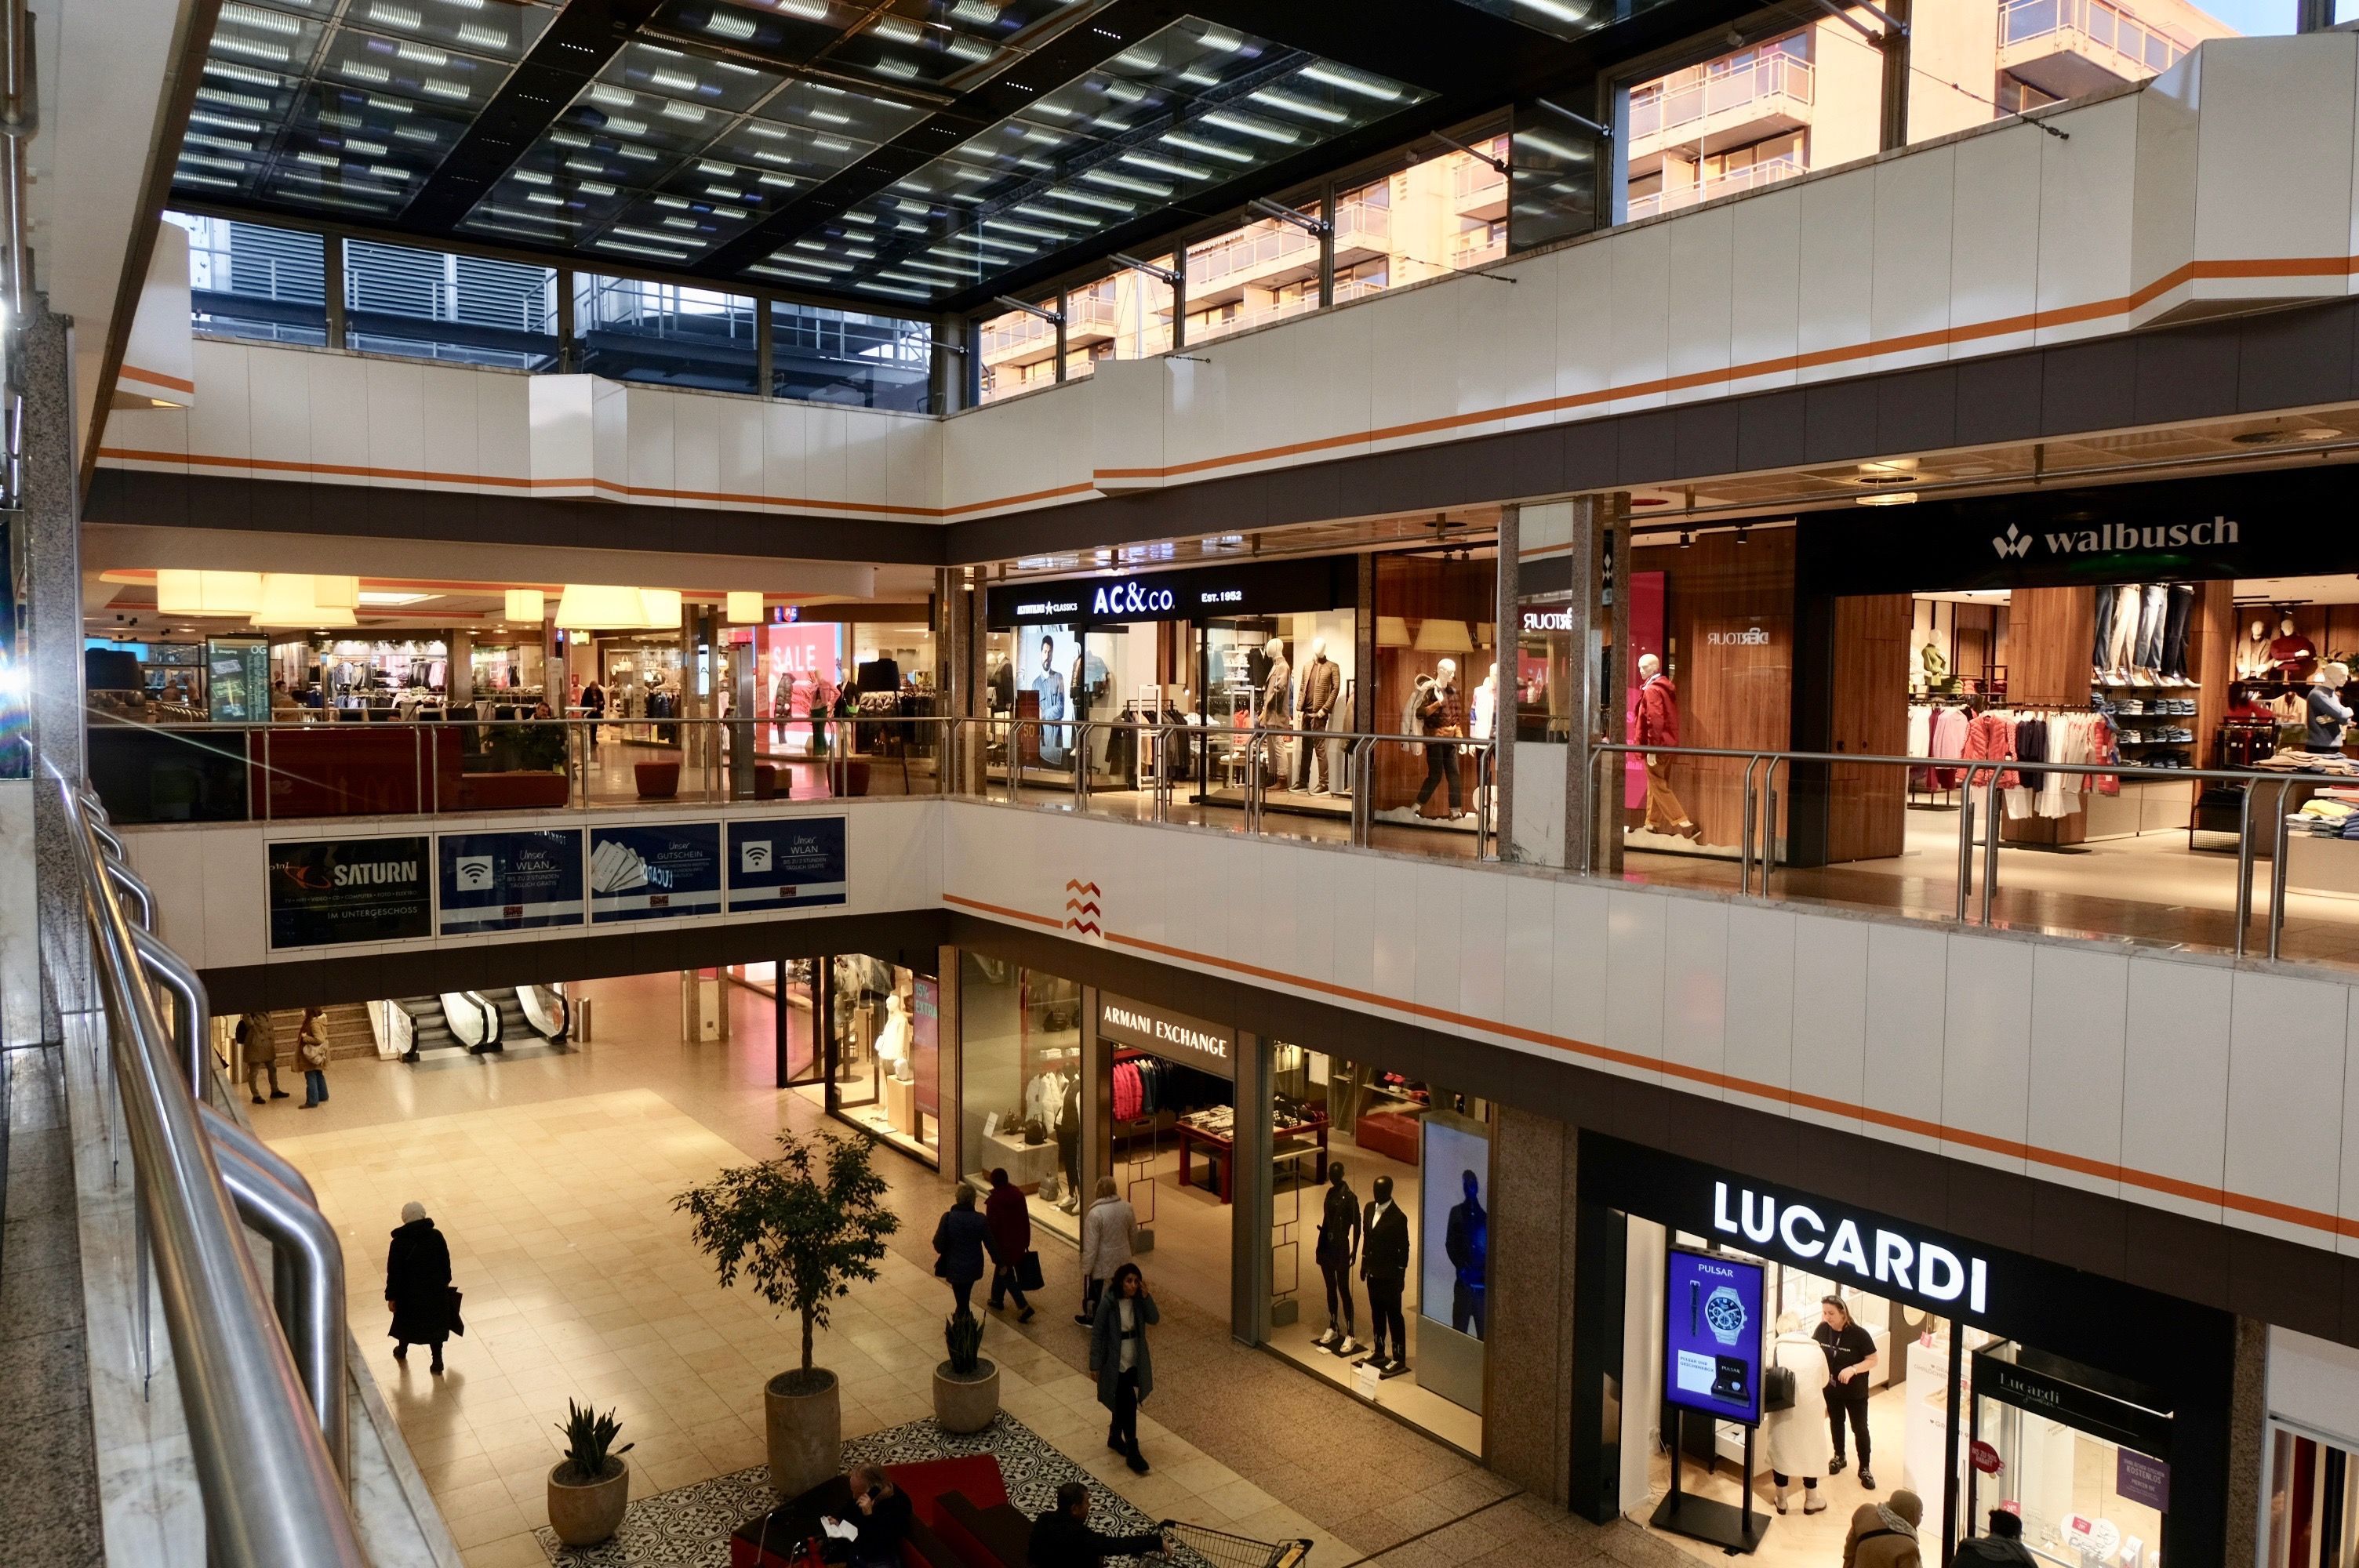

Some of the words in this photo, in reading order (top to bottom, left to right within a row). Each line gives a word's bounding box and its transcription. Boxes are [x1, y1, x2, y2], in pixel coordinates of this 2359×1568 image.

[2045, 515, 2239, 554] walbusch
[250, 644, 267, 655] OG
[773, 644, 816, 672] SALE
[668, 840, 691, 851] Unser
[794, 835, 816, 845] Unser
[519, 849, 548, 860] Unser
[657, 851, 703, 860] GUTSCHEIN
[791, 845, 819, 855] WLAN
[516, 860, 551, 871] WLAN
[333, 861, 417, 887] SATURN
[342, 906, 418, 919] UNTERGESCHOSS
[915, 1000, 937, 1019] EXTRA
[1104, 1005, 1150, 1034] ARMANI
[1155, 1020, 1227, 1058] EXCHANGE
[1714, 1181, 1987, 1314] LUCARDI
[1698, 1263, 1734, 1278] PULSAR
[1680, 1361, 1714, 1373] GESCHENKBOX
[1721, 1365, 1740, 1374] PULSAR
[2000, 1372, 2059, 1404] Lucardi
[2126, 1465, 2161, 1484] KOSTENLOS
